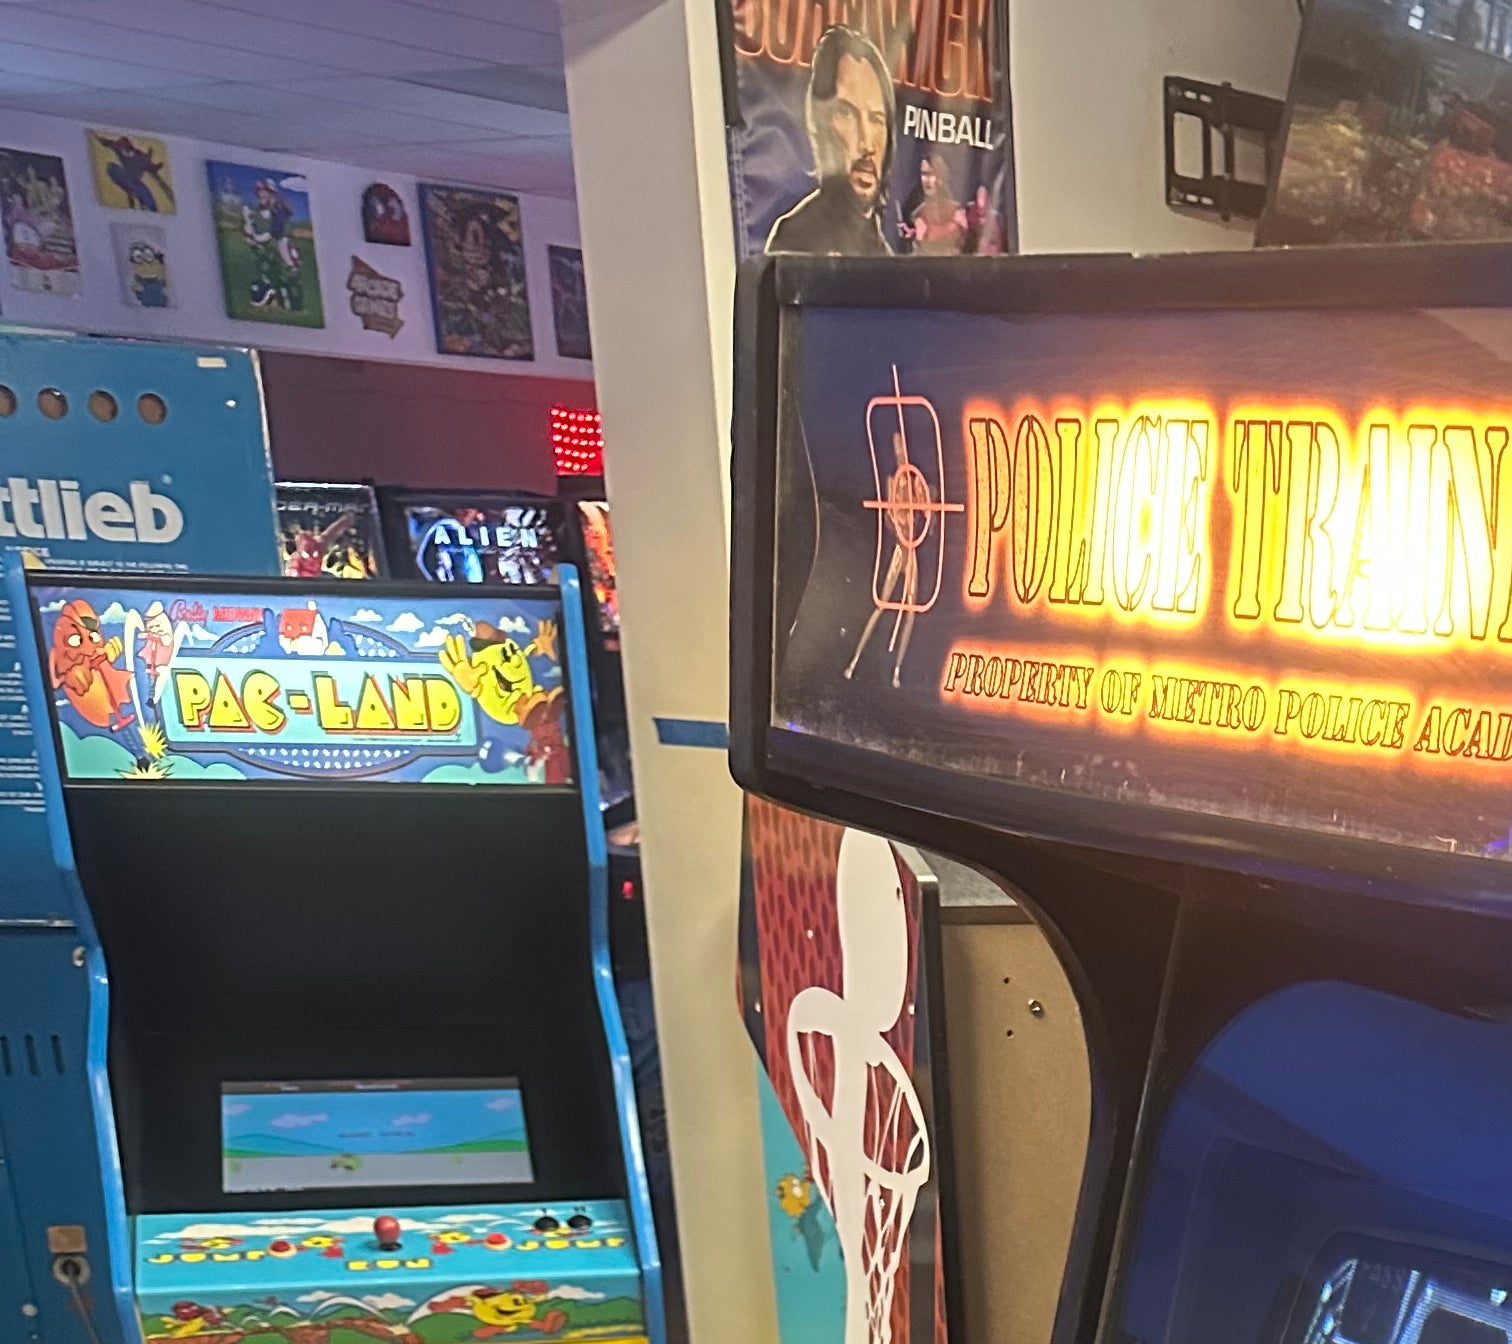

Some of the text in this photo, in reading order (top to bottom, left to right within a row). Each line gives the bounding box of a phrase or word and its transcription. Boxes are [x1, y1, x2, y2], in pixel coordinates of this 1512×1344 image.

[904, 105, 994, 149] PINBALL
[434, 525, 538, 548] ALIEN
[968, 414, 1210, 613] POLICE
[170, 666, 463, 736] PAC-LAND
[943, 652, 1095, 709] PROPERTY
[1100, 669, 1142, 716] OF
[1148, 674, 1267, 732] METRO
[1274, 689, 1411, 749] POLICE
